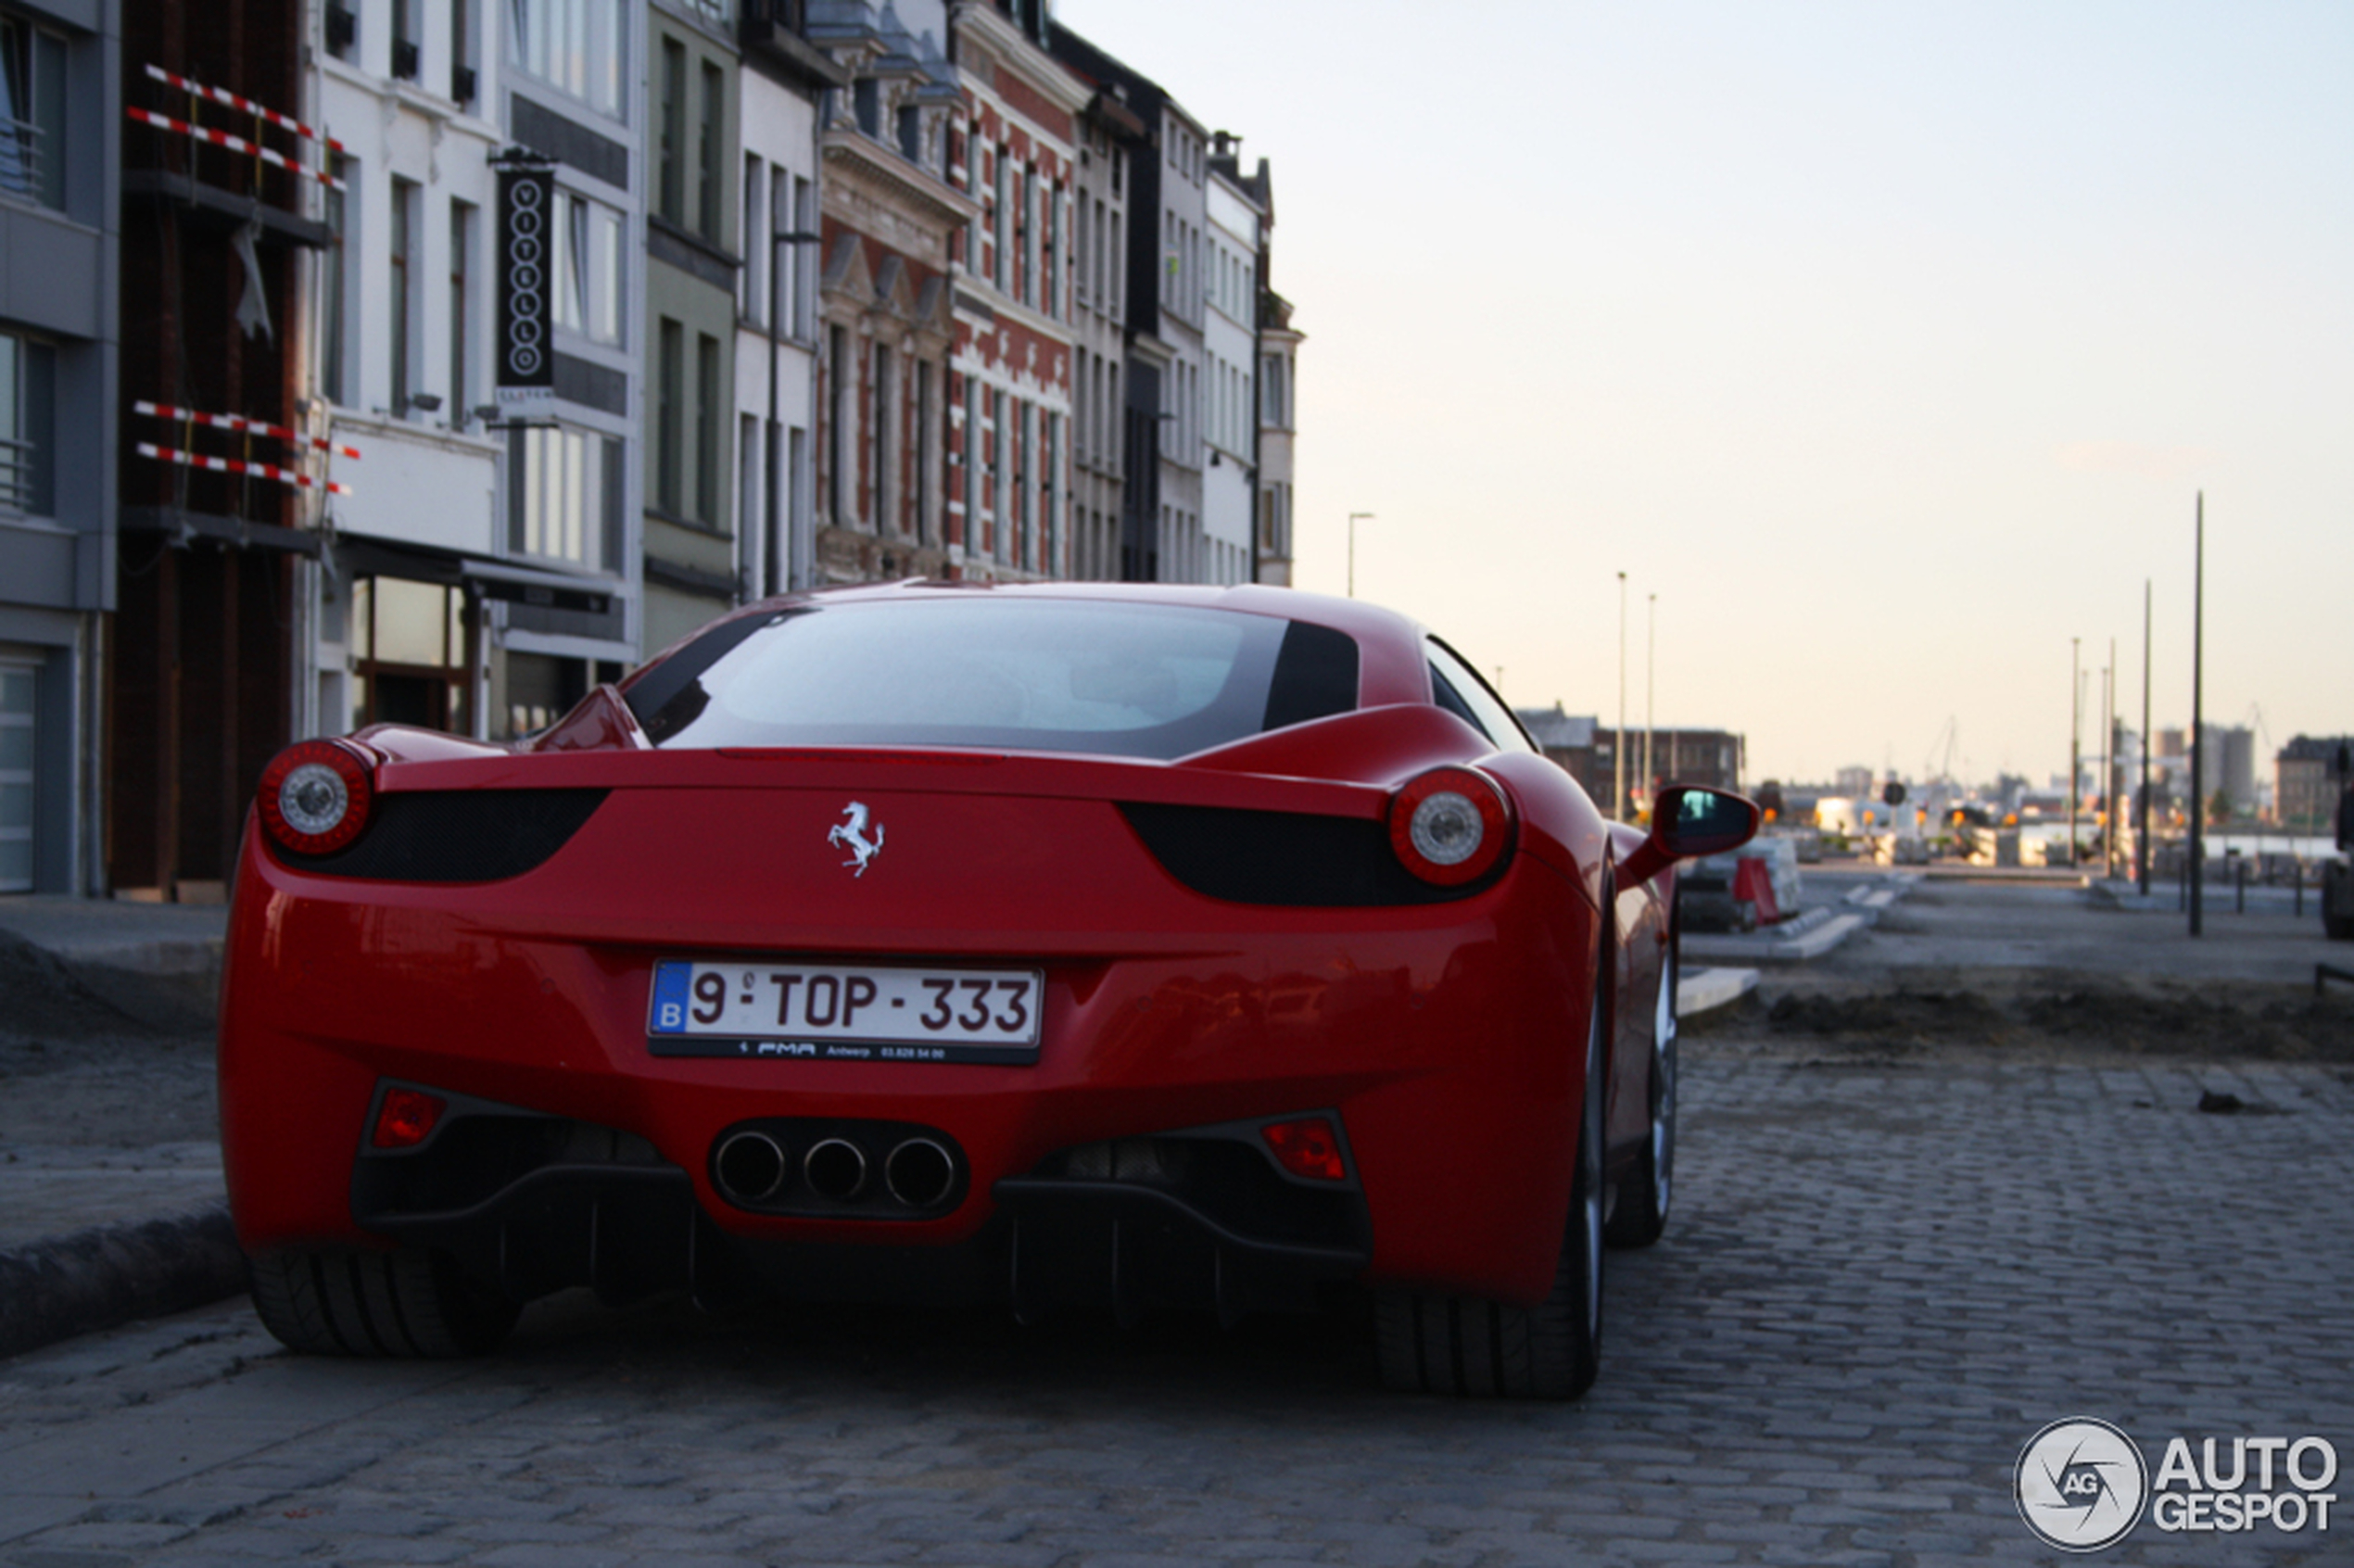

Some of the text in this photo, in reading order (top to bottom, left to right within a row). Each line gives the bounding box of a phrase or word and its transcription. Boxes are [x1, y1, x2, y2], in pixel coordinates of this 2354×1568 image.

[516, 187, 535, 367] VITELLO
[661, 1003, 681, 1027] B
[827, 1045, 870, 1058] Antwerp
